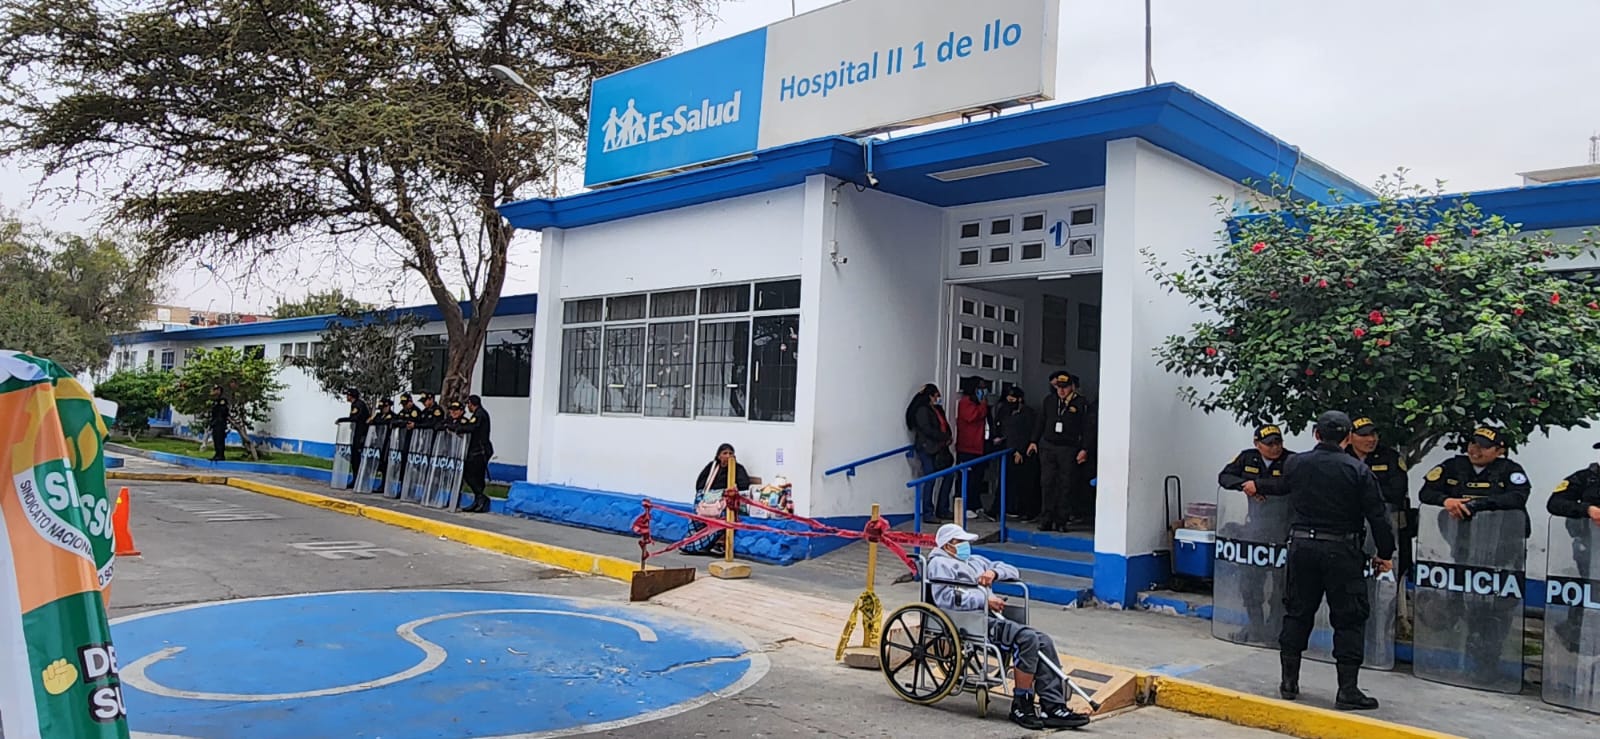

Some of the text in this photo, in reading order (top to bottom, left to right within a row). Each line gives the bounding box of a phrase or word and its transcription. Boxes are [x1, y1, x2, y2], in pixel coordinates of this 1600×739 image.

[780, 18, 1021, 102] Hospital II 1 de Ilo
[647, 90, 742, 142] EsSalud
[1049, 221, 1062, 247] 1
[20, 480, 51, 529] SINDICATO
[1215, 539, 1287, 568] POLICIA
[1416, 564, 1522, 599] POLICIA
